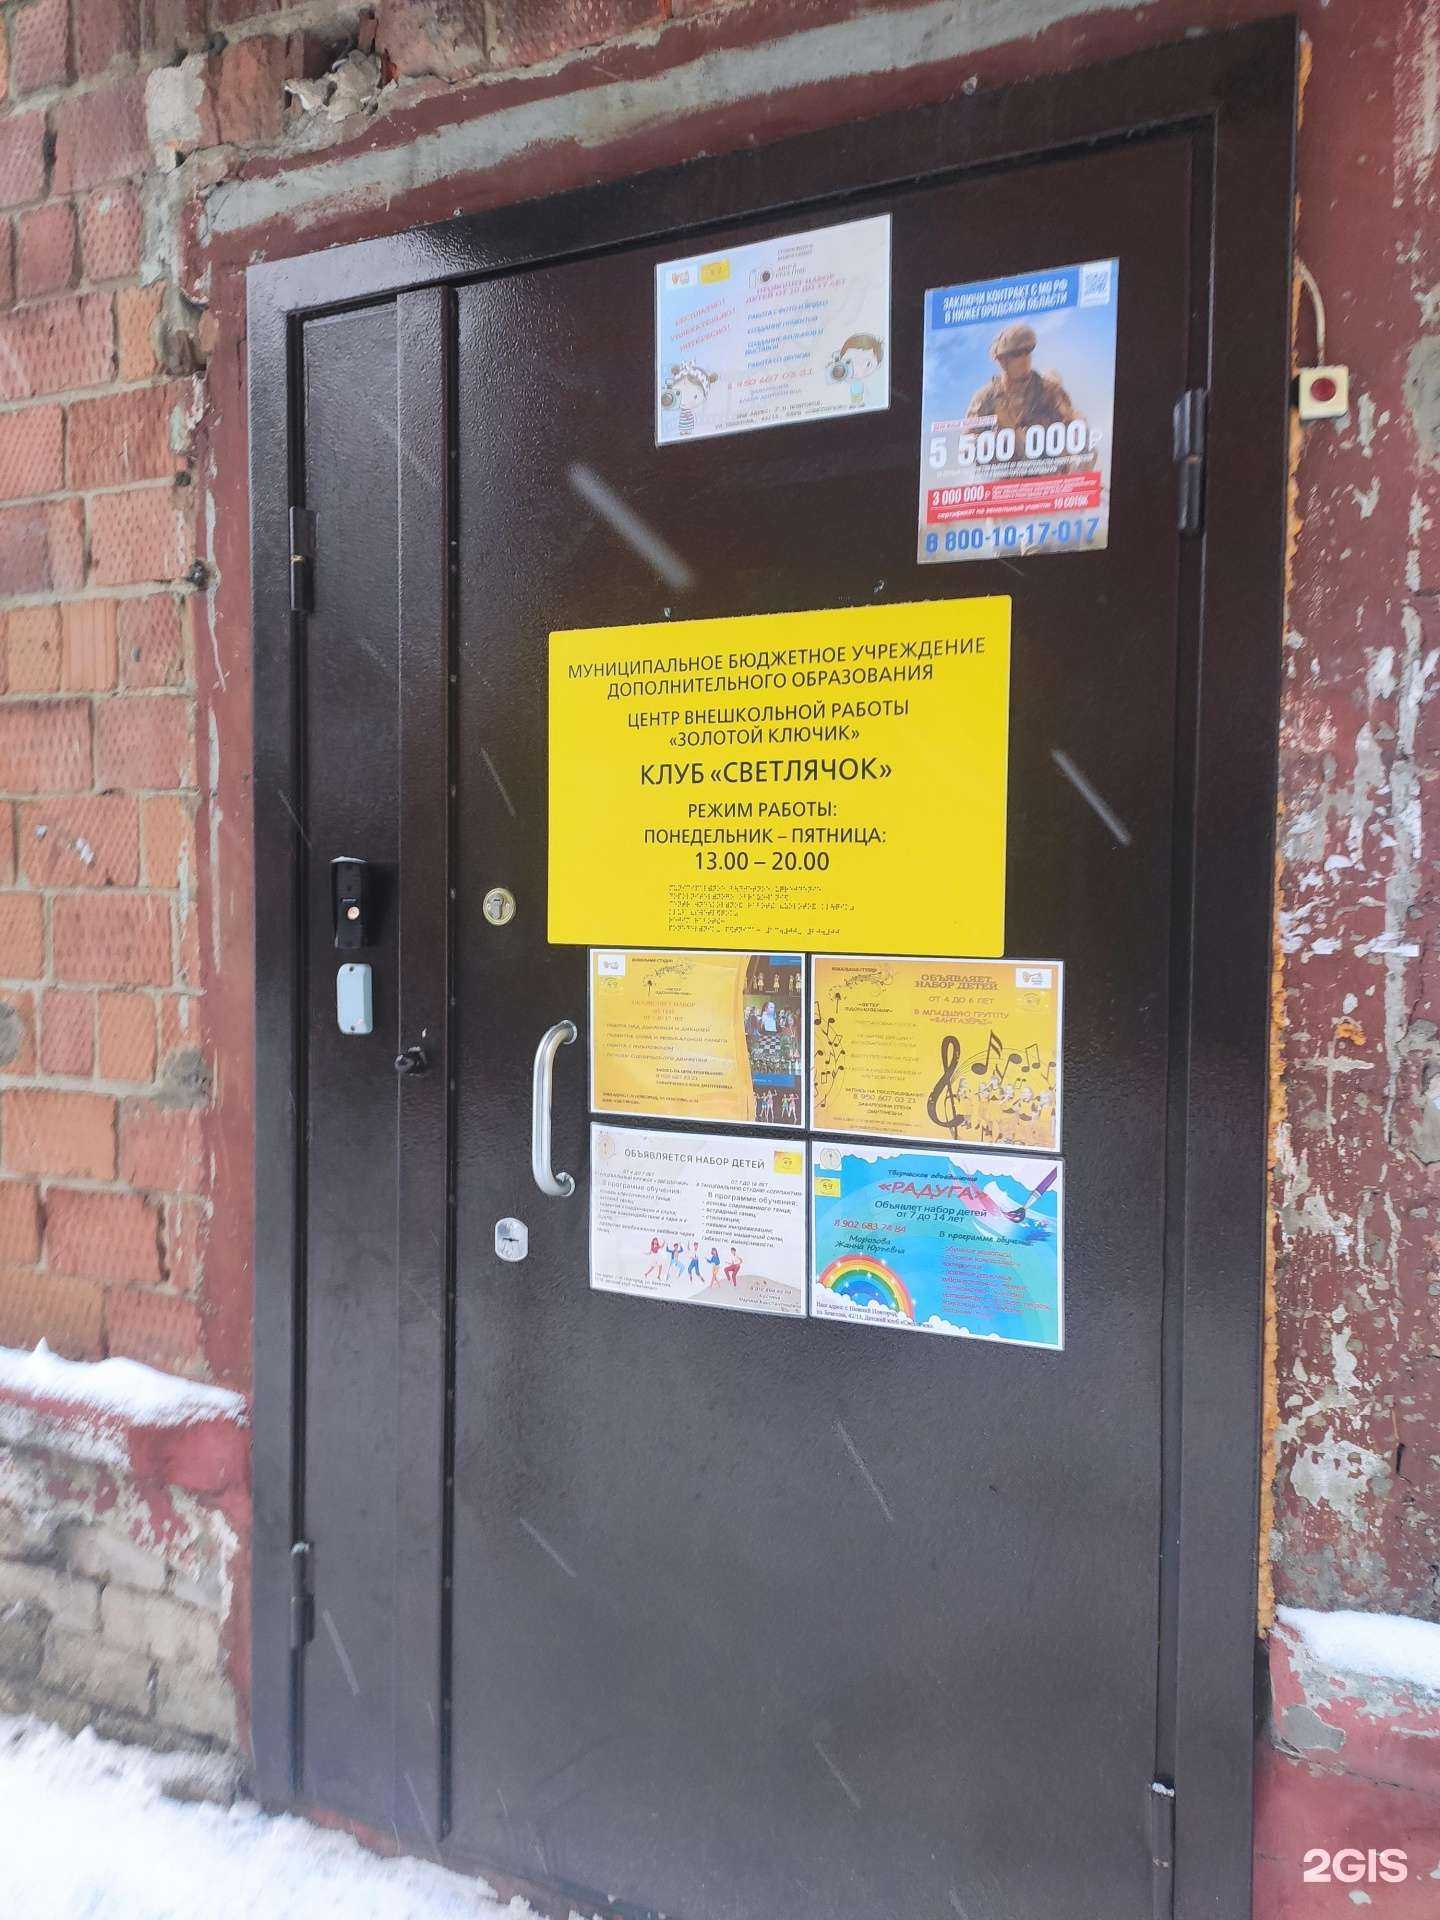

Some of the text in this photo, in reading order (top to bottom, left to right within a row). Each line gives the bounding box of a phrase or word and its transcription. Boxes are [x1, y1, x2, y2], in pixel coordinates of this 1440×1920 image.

[943, 291, 985, 310] ЗАКЛЮЧИ
[986, 284, 1030, 304] КОНТРАКТ
[1053, 278, 1069, 291] РФ
[951, 298, 1027, 323] НИЖЕГОРОДСКОЙ
[1027, 292, 1068, 310] ОБЛАСТИ
[929, 436, 948, 469] 5
[958, 428, 1016, 466] 500
[1025, 418, 1086, 460] 000
[942, 488, 962, 504] 000
[964, 485, 984, 502] 000
[568, 637, 986, 679] МУНИЦИПАЛЬНОЕ БЮДЖЕТНОЕ УЧРЕЖДЕНИЕ
[607, 664, 933, 700] ДОПОЛНИТЕЛЬНОГО ОБРАЗОВАНИЯ
[629, 699, 909, 730] ЦЕНТР ВНЕШКОЛЬНОЙ РАБОТЫ
[669, 725, 860, 746] «ЗОЛОТОЙ КЛЮЧИК»
[641, 757, 892, 785] КЛУБ «СВЕТЛЯЧОК»
[688, 801, 838, 819] РЕЖИМ РАБОТЫ:
[645, 828, 773, 846] ПОНЕДЕЛЬНИК
[791, 827, 887, 846] ПЯТНИЦА:
[695, 851, 749, 871] 13.00
[771, 851, 830, 871] 20.00
[914, 980, 1000, 991] НАБОР ДЕТЕЙ
[920, 974, 993, 983] ОБЪЯВЛЯЕТ
[624, 1149, 766, 1169] ОБЪЯВЛЯЕТСЯ НАБОР ДЕТЕЙ
[714, 1193, 757, 1203] программе
[878, 1181, 986, 1200] «РАДУГА»
[917, 1213, 931, 1221] до
[934, 1213, 946, 1221] 14
[947, 1216, 965, 1224] лет
[924, 1204, 955, 1216] набор
[957, 1207, 988, 1218] детей
[947, 1233, 994, 1243] программе
